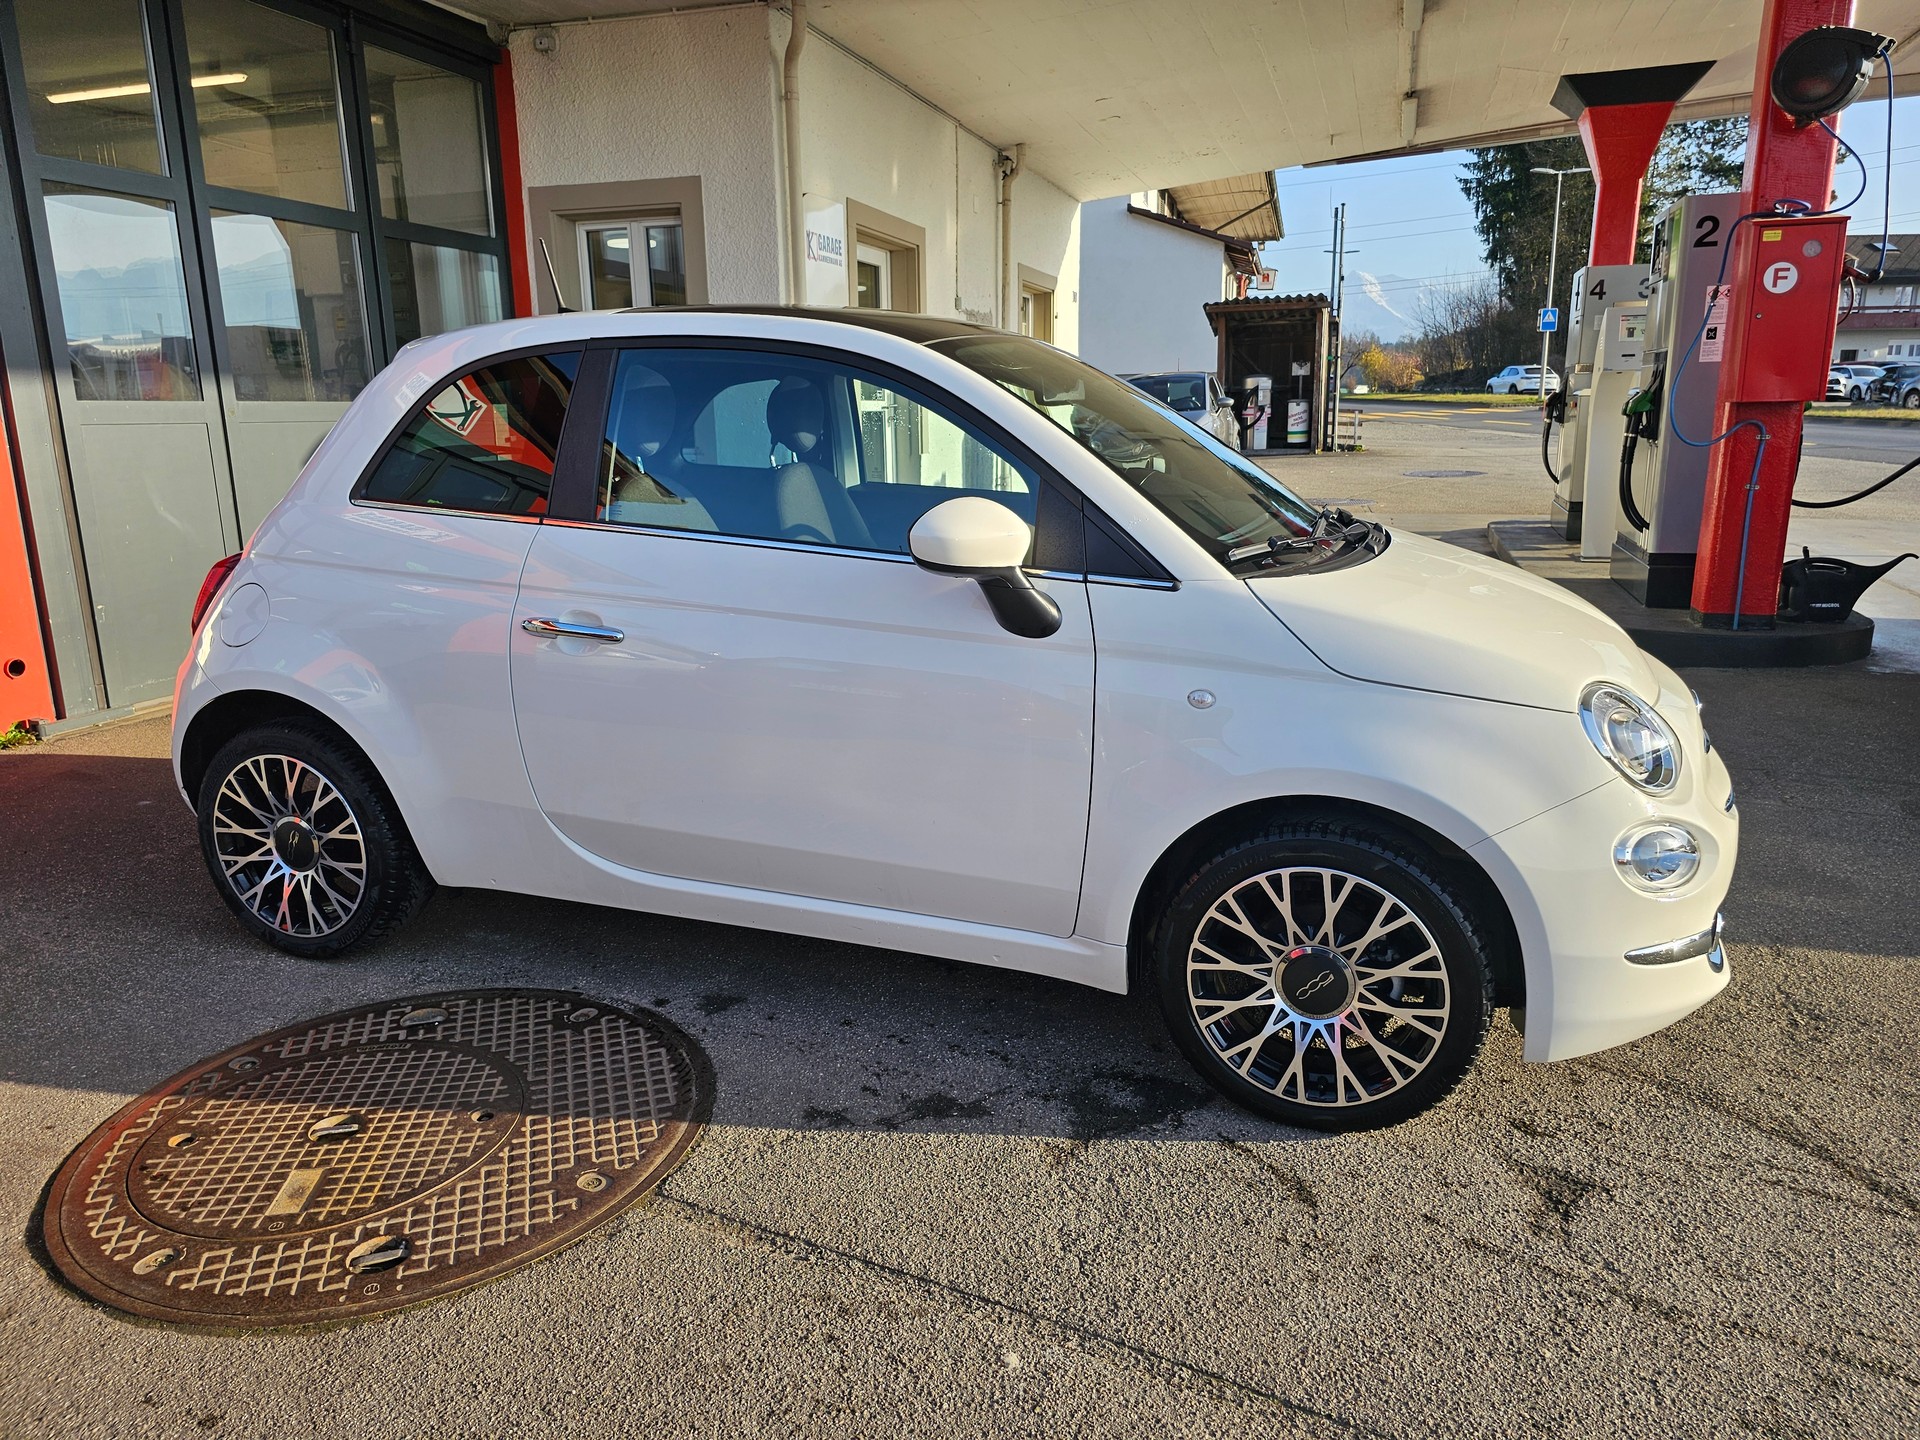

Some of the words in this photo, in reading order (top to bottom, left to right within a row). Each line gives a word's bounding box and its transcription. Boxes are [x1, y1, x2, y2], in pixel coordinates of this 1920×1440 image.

[1693, 215, 1720, 248] 2
[818, 233, 842, 257] GARAGE
[1590, 279, 1606, 300] 4
[1638, 278, 1649, 299] 3
[1772, 267, 1791, 288] F
